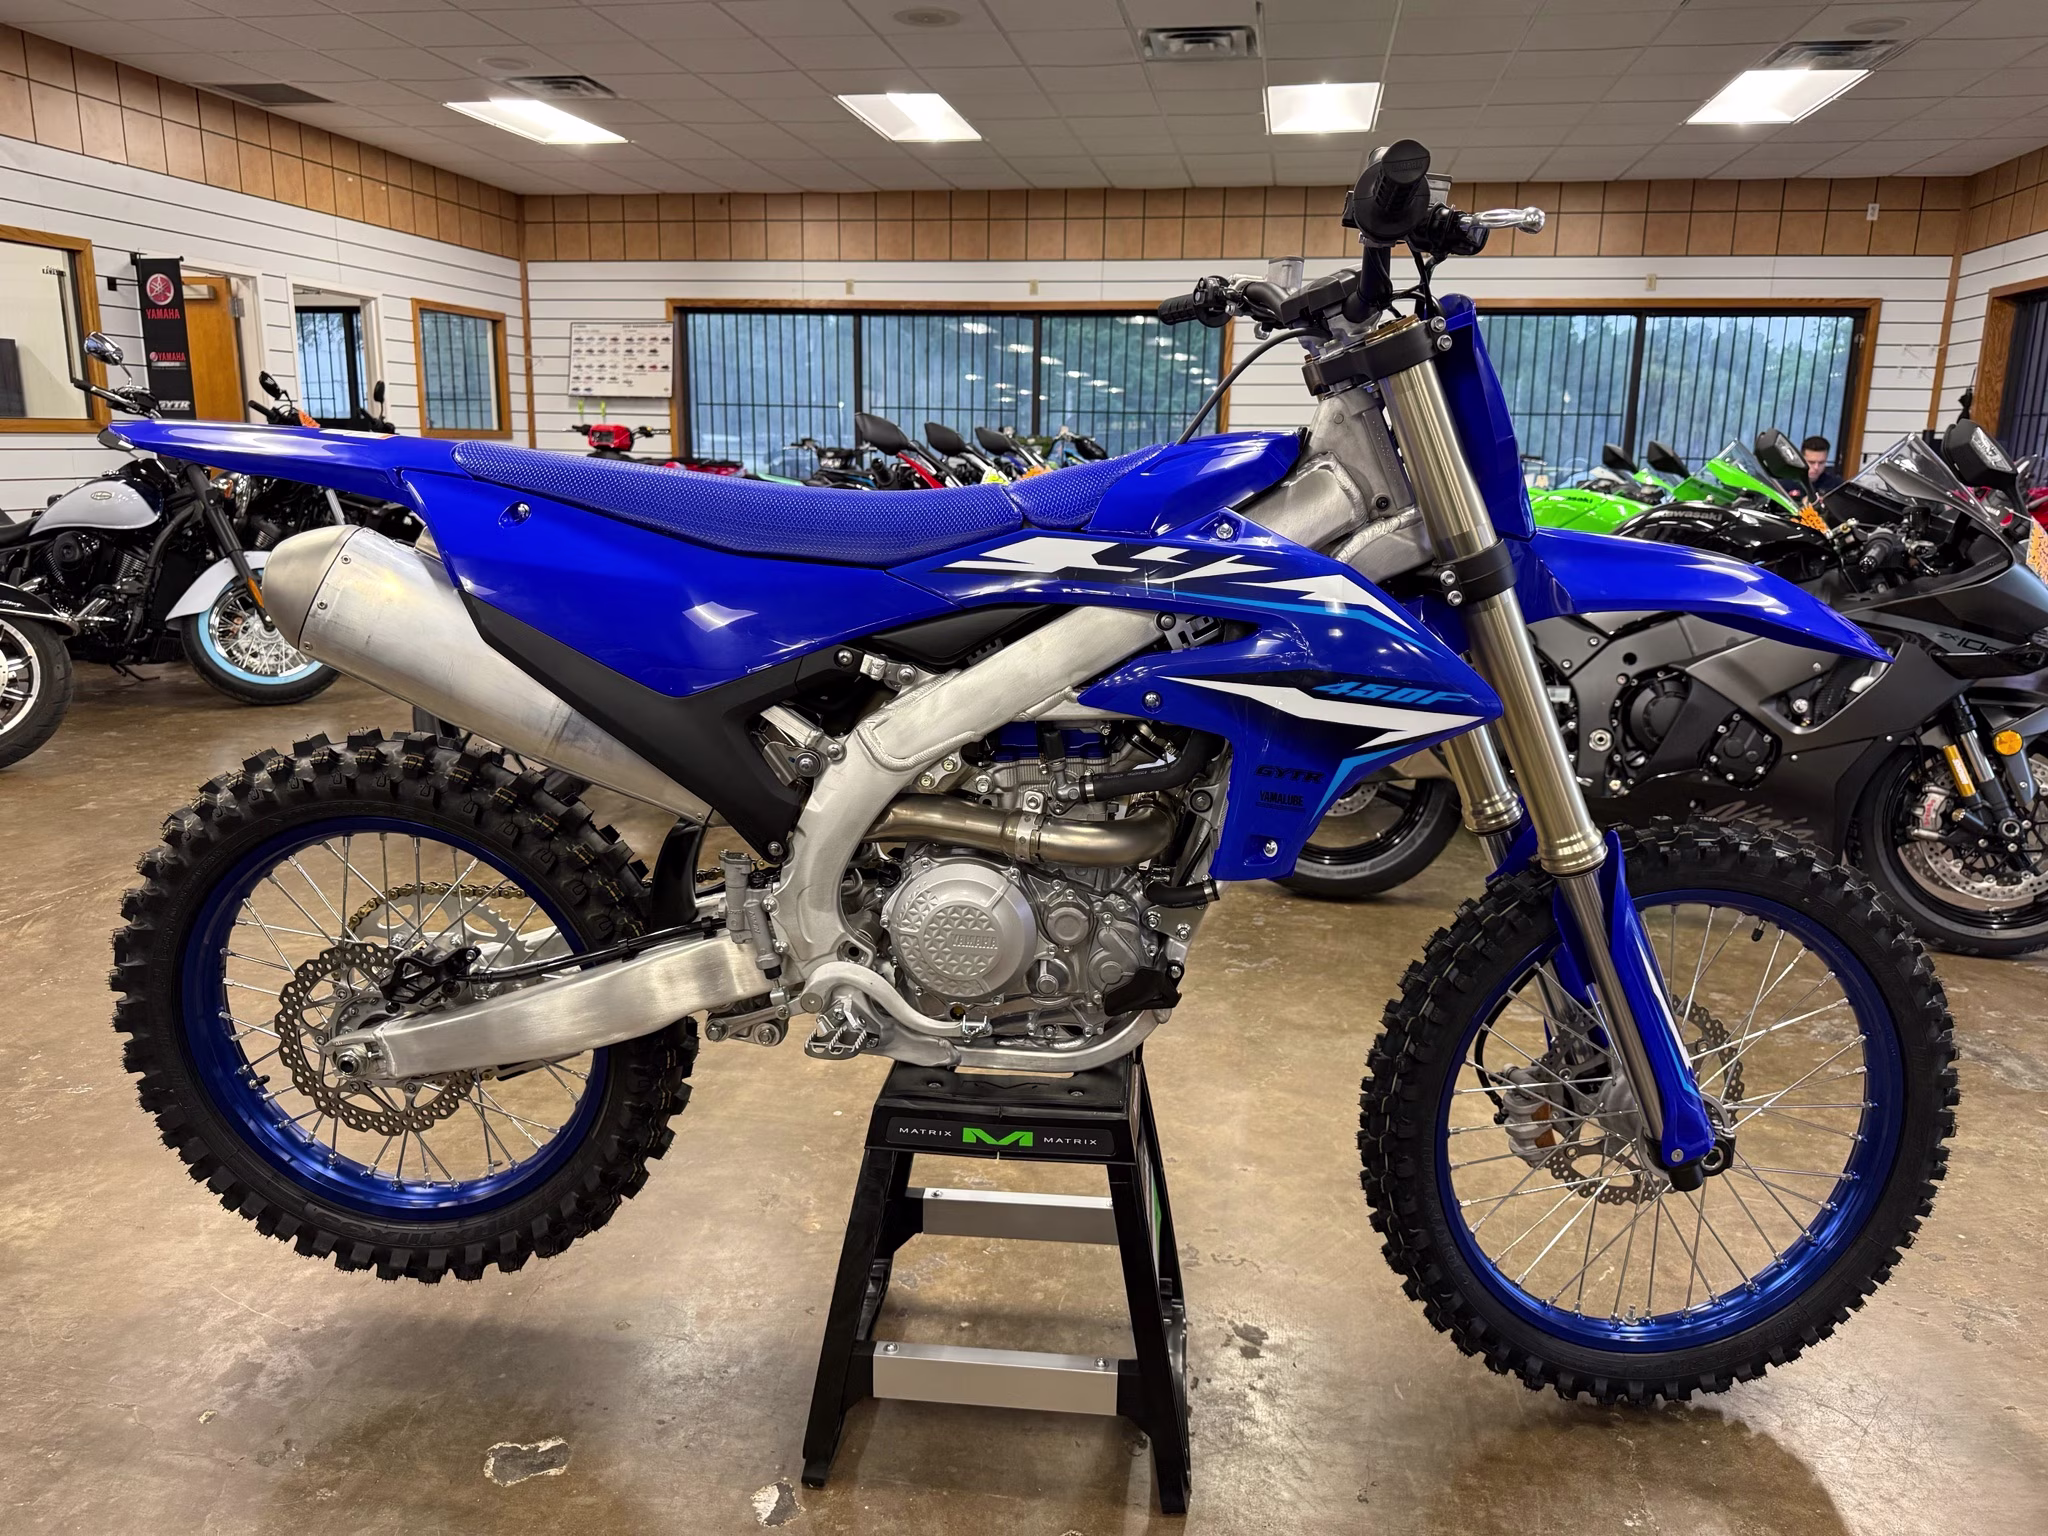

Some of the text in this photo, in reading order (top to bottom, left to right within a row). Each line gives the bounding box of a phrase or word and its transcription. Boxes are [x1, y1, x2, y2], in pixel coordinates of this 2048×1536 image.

[146, 308, 181, 320] YAMAHA
[157, 352, 186, 361] YAMAHA
[1659, 509, 1723, 522] awasaki
[1311, 681, 1473, 705] 450F
[1255, 765, 1325, 783] GYTR
[1260, 790, 1304, 807] YAMALUBE
[952, 934, 999, 950] YAMAHA
[899, 1127, 952, 1137] MATRIX
[1043, 1137, 1097, 1146] MATRIX
